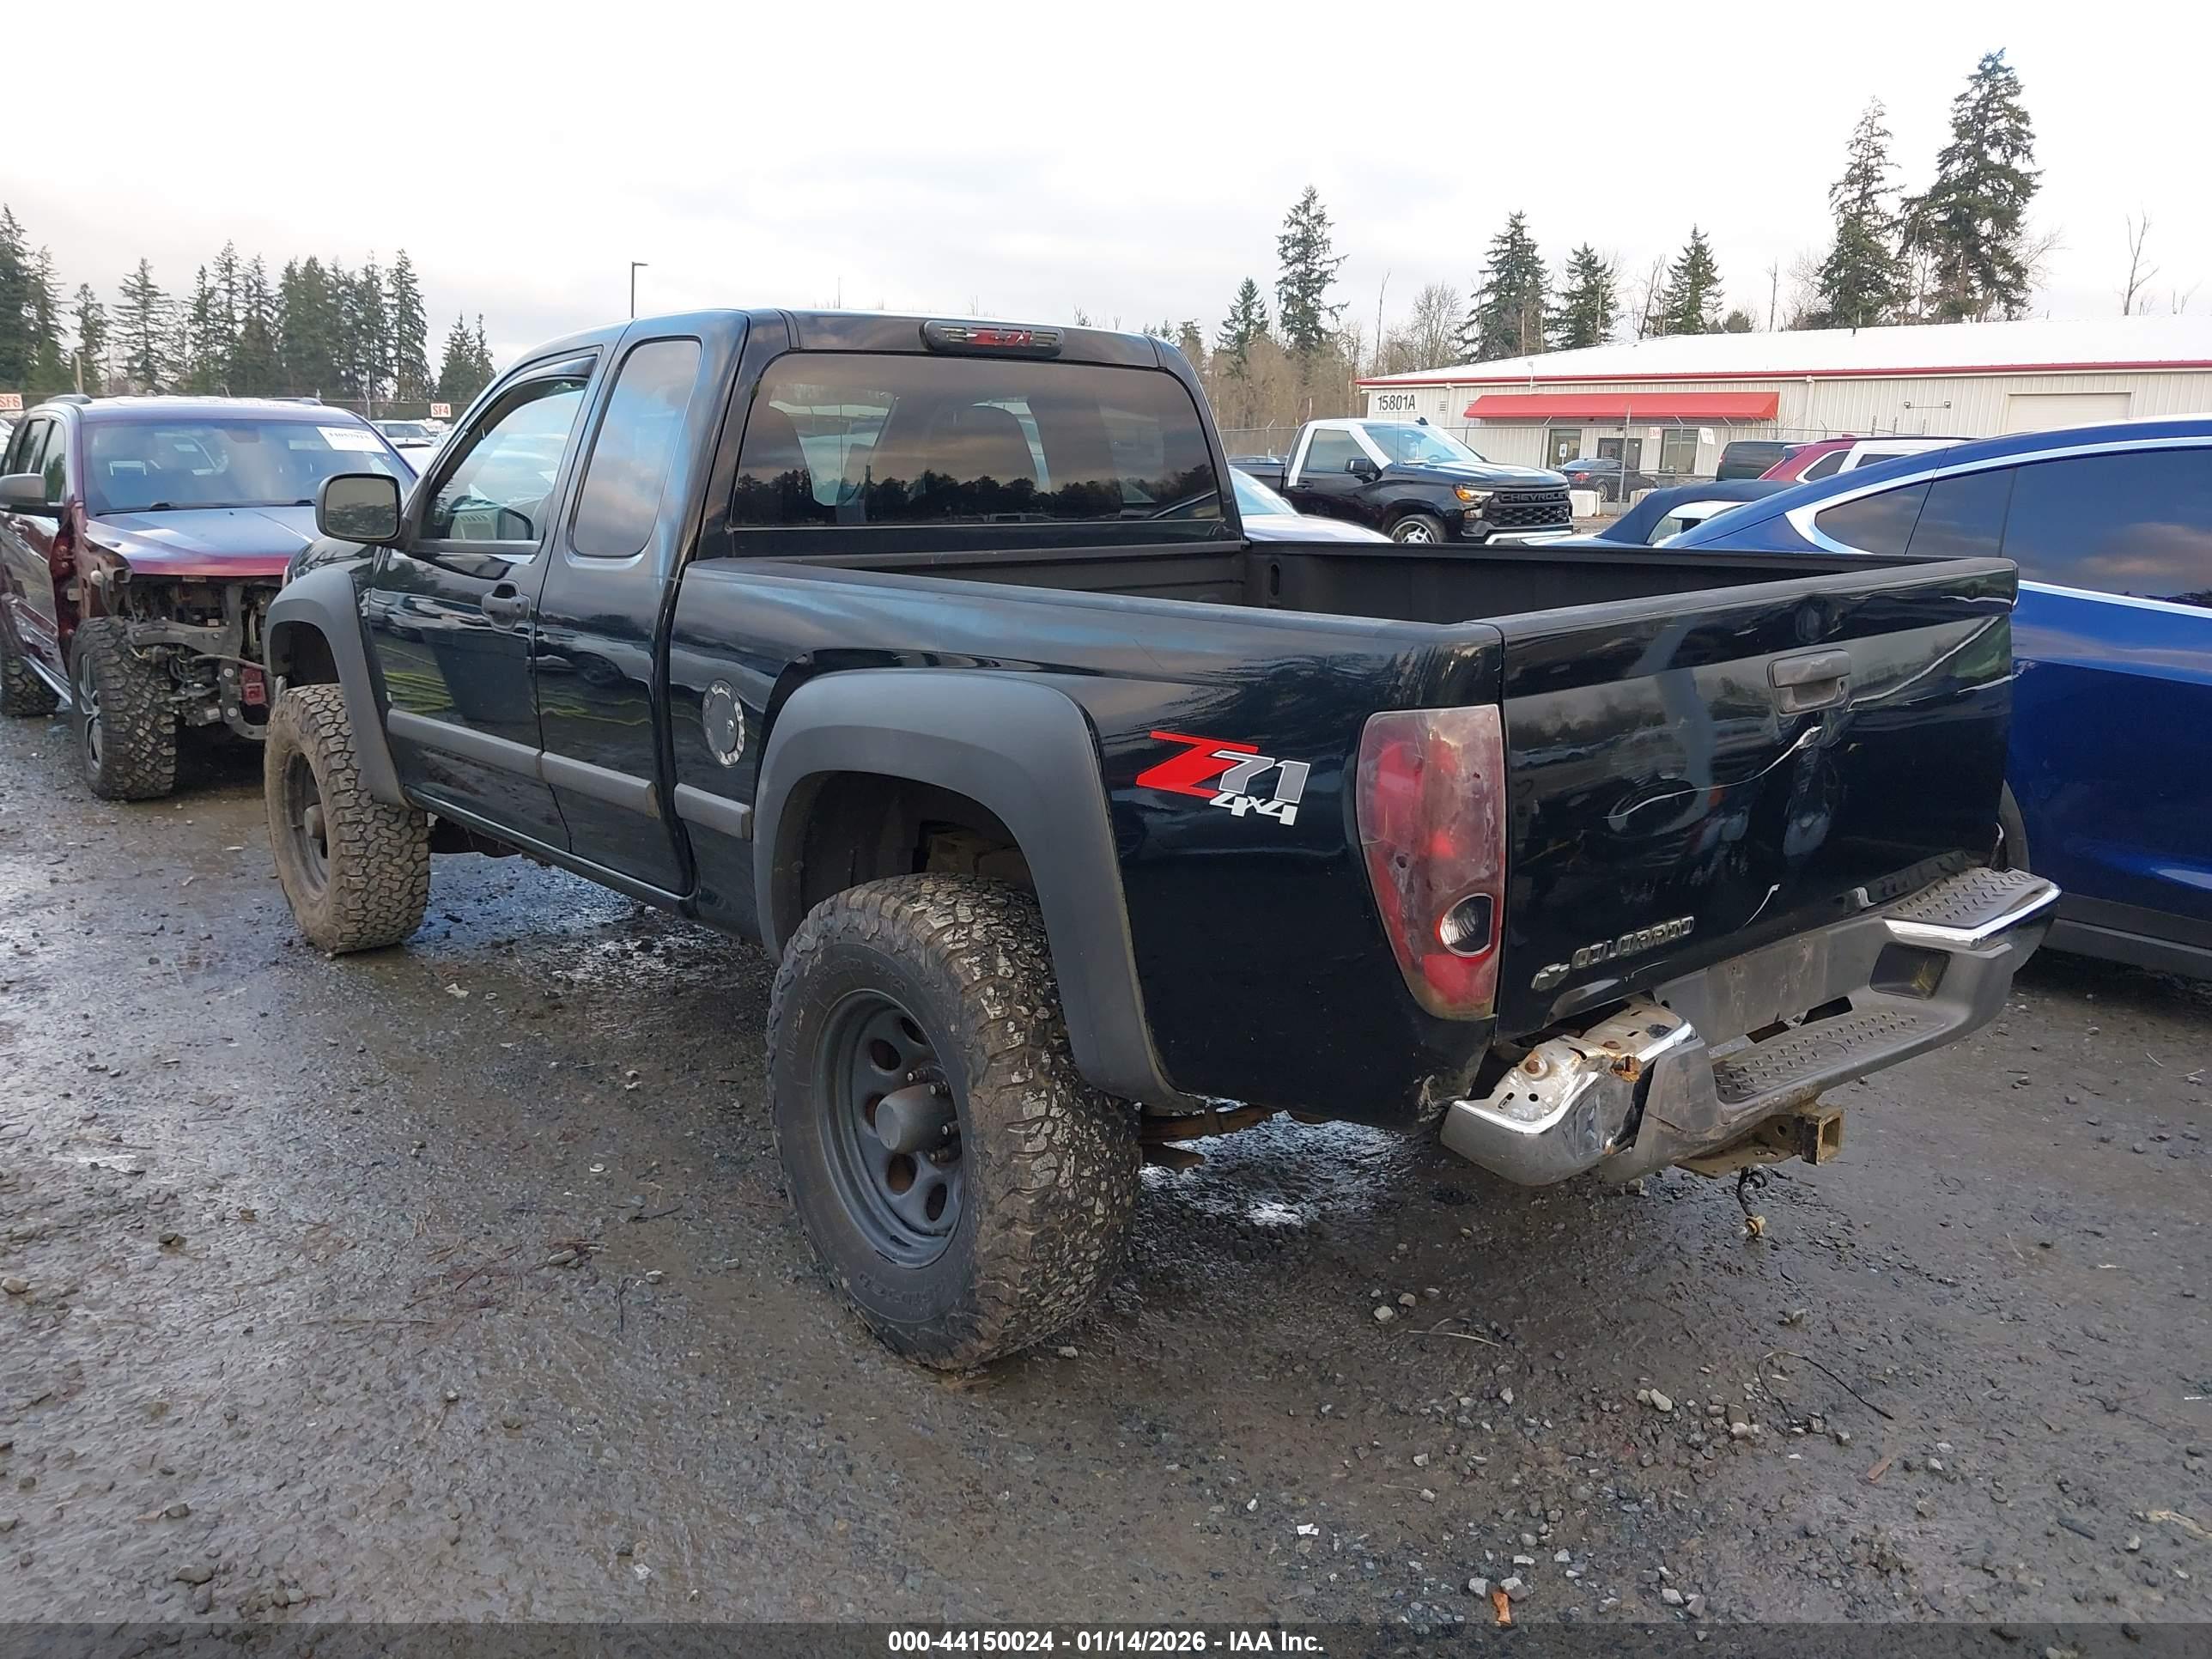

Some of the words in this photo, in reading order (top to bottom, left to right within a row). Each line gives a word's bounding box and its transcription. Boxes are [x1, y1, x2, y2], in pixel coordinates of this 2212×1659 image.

[433, 405, 448, 416] SF4
[1377, 395, 1415, 410] 15801A
[1135, 730, 1310, 804] Z71
[1572, 915, 1694, 969] COLORADO
